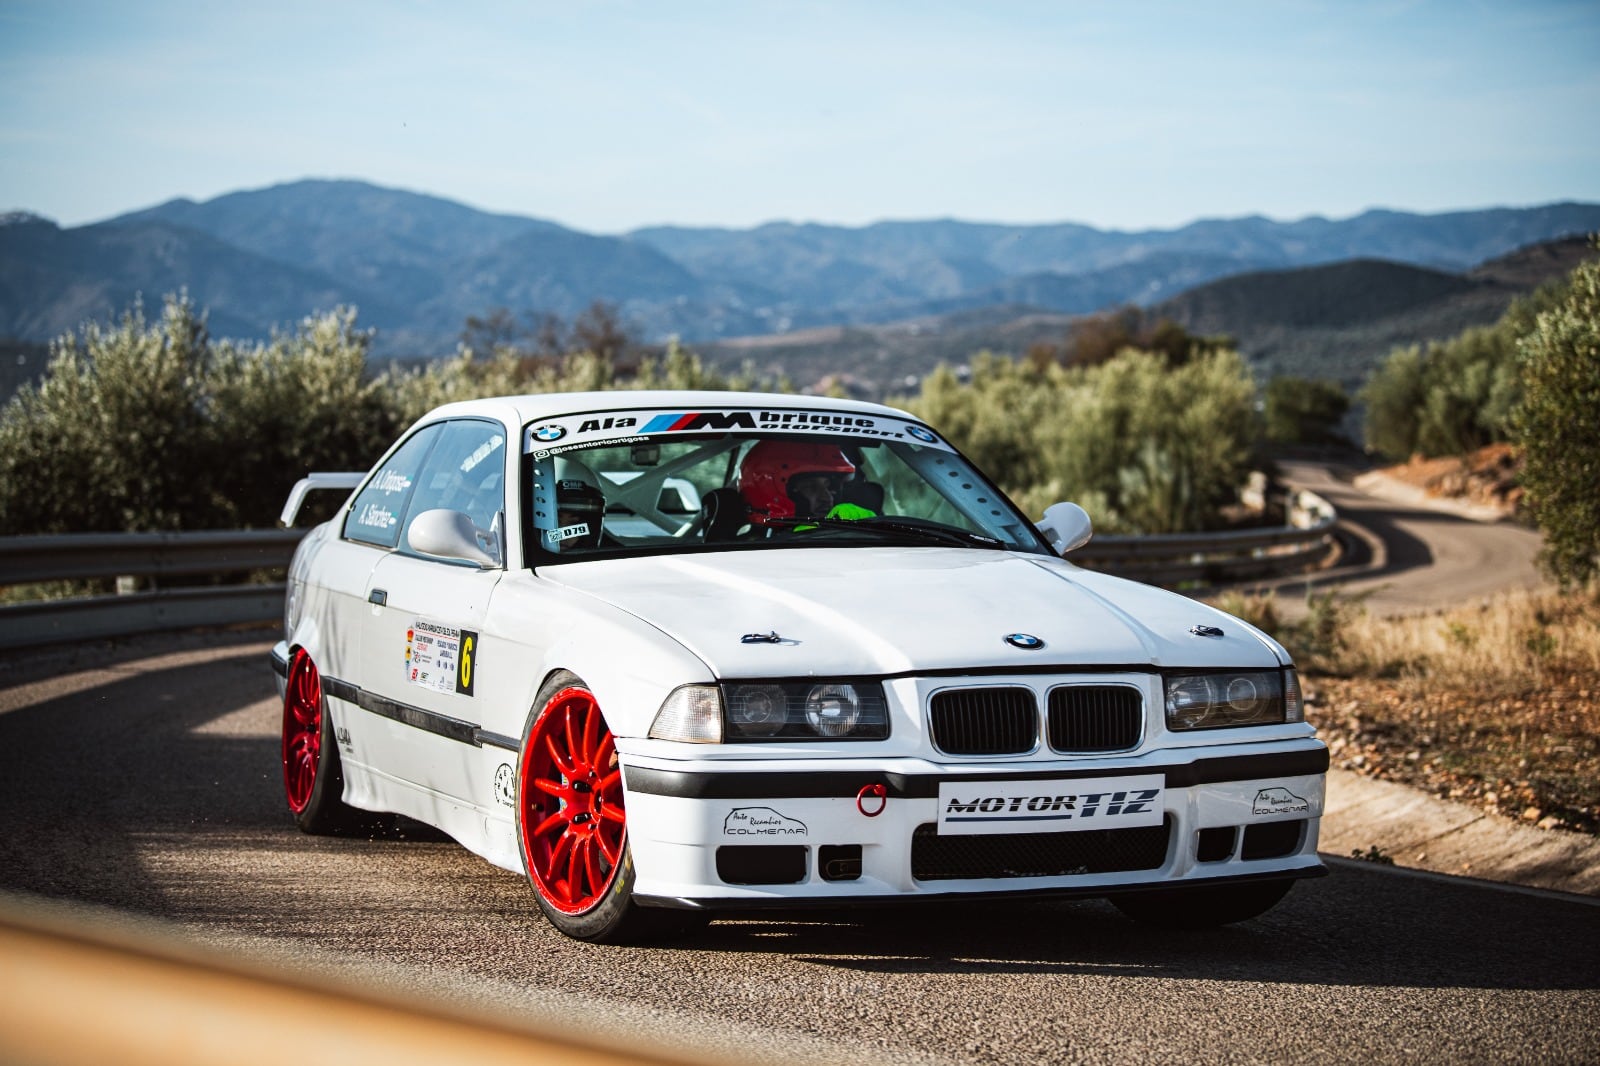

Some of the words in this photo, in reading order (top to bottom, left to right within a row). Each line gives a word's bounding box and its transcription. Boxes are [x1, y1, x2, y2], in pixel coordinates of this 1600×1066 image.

[577, 417, 637, 433] Ala
[760, 411, 875, 428] brique
[760, 423, 904, 439] otorsport
[563, 526, 587, 537] D79
[461, 636, 473, 688] 6
[733, 811, 748, 820] Auto
[1254, 805, 1307, 815] COLMENAR
[749, 816, 782, 826] Recambios
